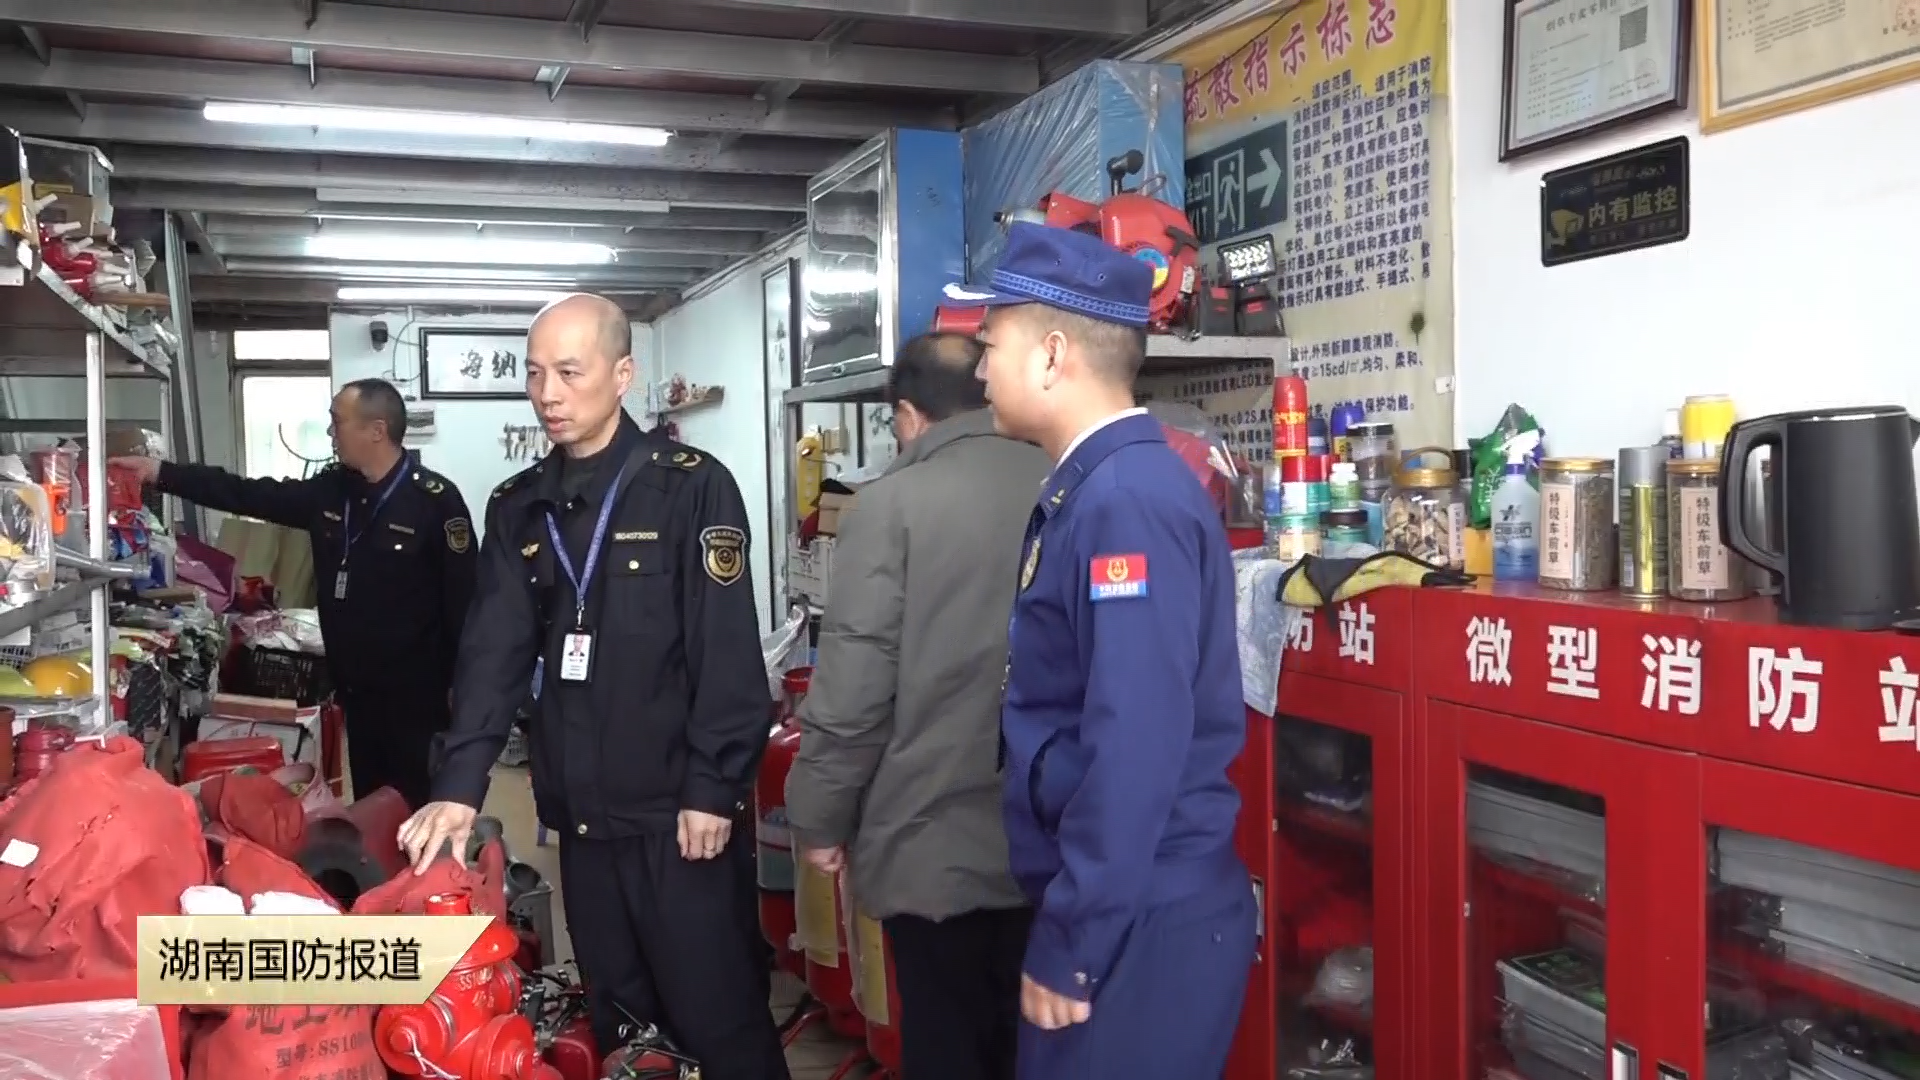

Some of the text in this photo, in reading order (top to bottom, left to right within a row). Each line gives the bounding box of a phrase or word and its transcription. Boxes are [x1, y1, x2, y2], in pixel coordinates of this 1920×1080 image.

[1588, 185, 1678, 229] 内有监控
[1548, 492, 1561, 564] 特级车前草
[1695, 497, 1711, 575] 特级车前草
